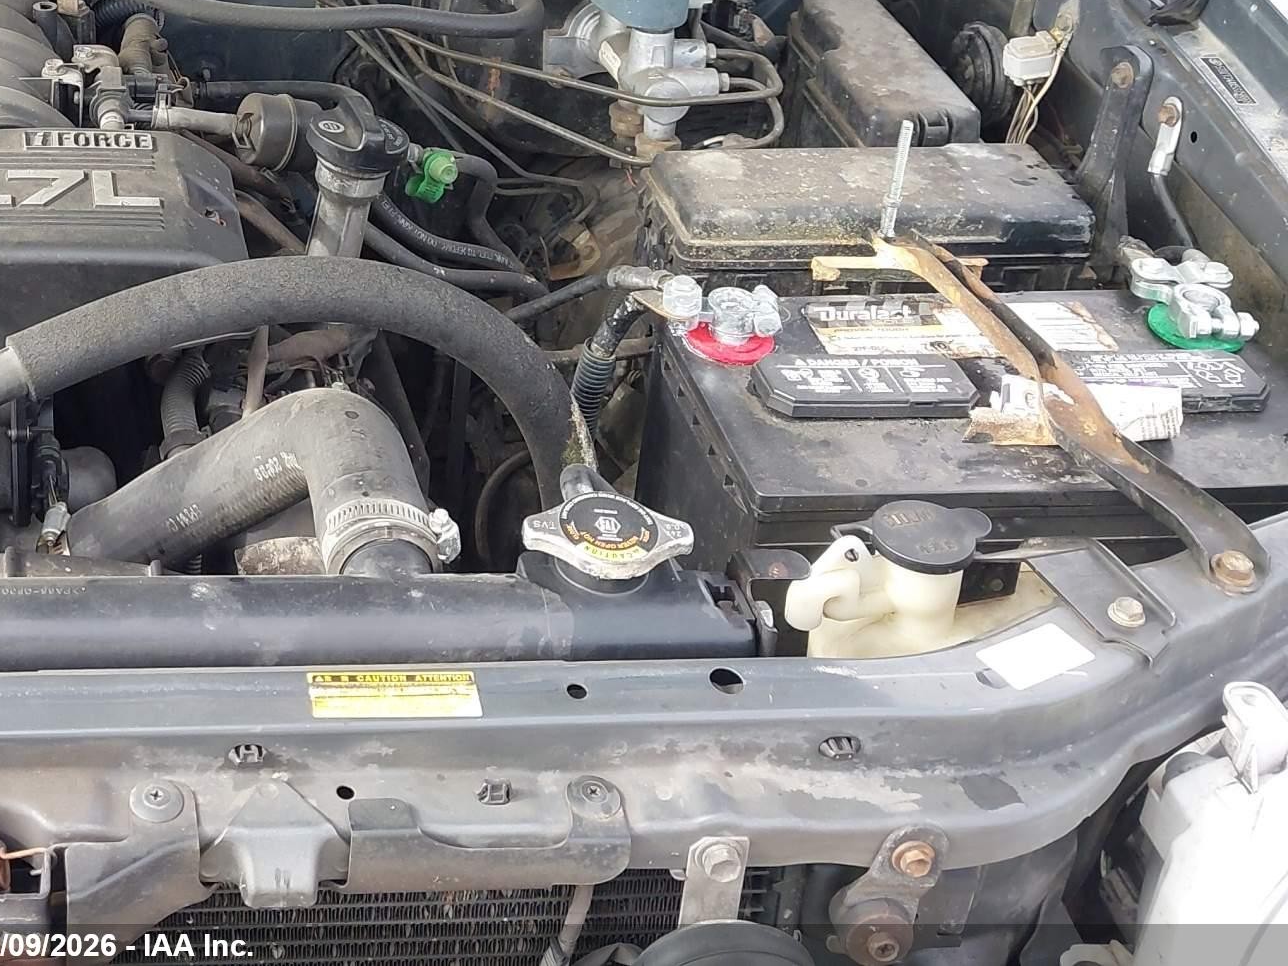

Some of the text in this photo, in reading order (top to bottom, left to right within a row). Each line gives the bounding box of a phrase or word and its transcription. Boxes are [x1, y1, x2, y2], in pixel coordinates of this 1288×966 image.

[57, 132, 152, 149] FORCE
[814, 305, 912, 322] Duralast
[805, 358, 861, 367] DANGER
[869, 358, 920, 367] POISON
[579, 530, 596, 543] HOT
[594, 539, 617, 549] OPEN
[583, 545, 633, 558] CAUTION
[357, 674, 407, 683] CAUTION
[415, 673, 470, 683] ATTENTION
